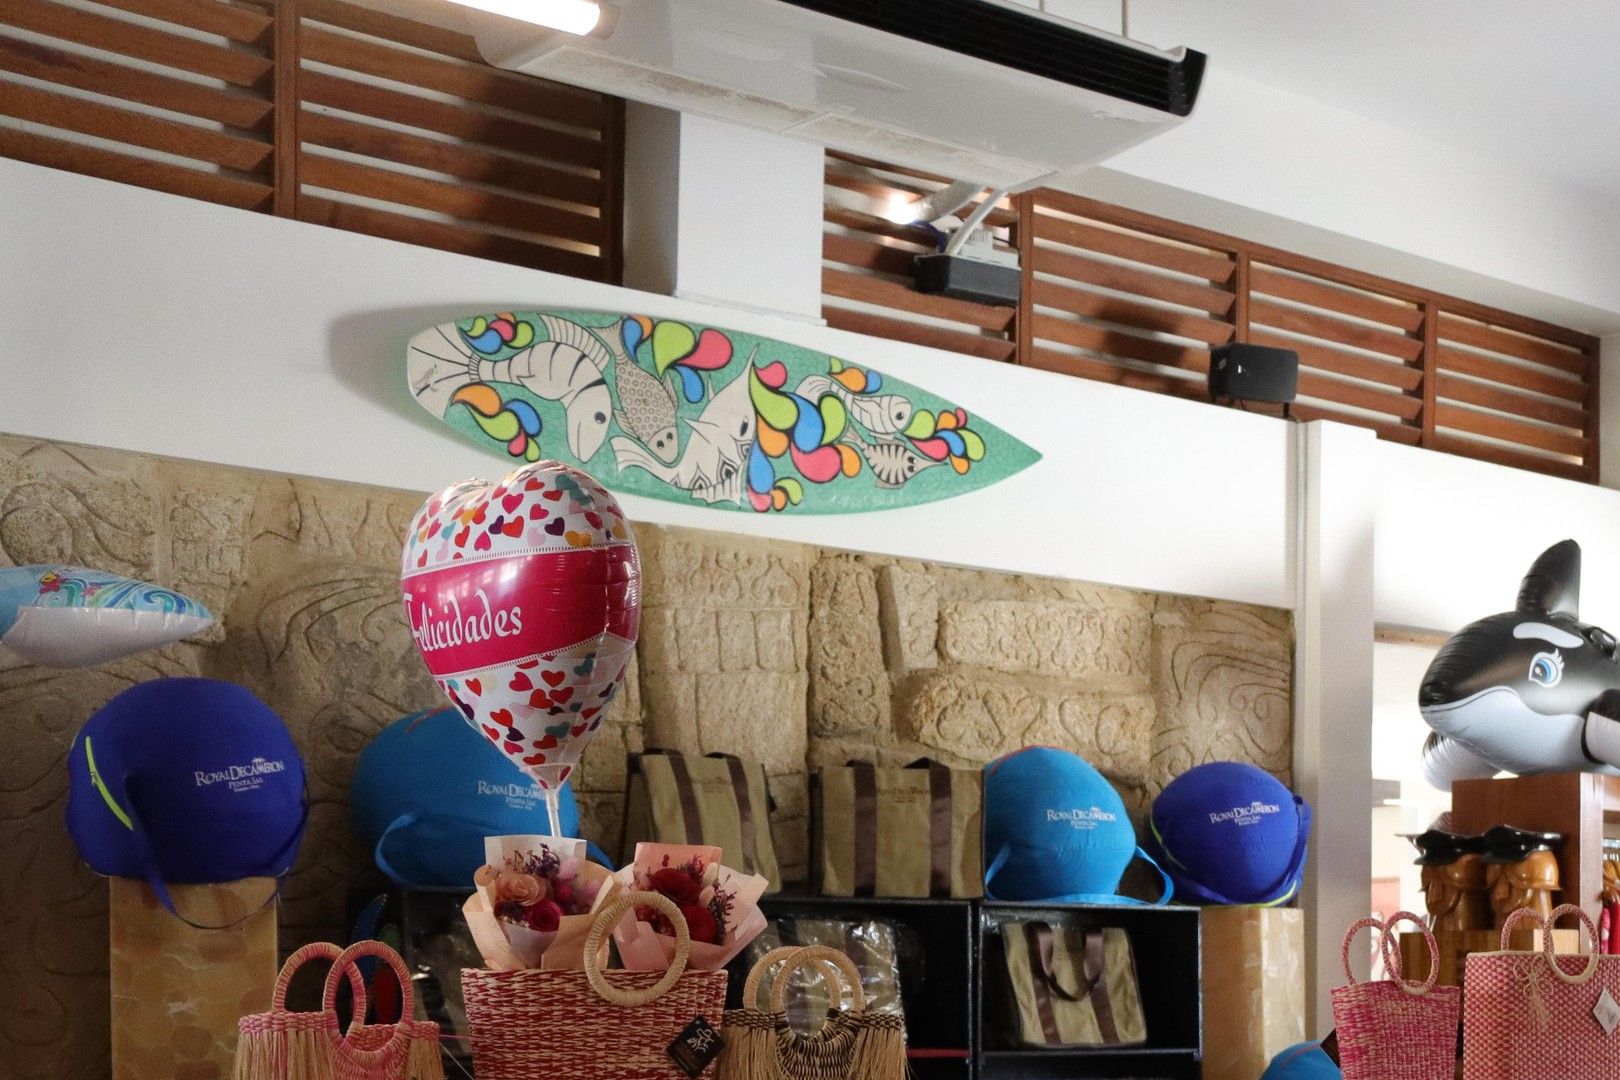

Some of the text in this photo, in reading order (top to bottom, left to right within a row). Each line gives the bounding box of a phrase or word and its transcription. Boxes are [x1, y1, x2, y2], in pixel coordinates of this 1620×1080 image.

[403, 588, 522, 652] Felicidades
[195, 759, 284, 786] ROYAL DECAMERON
